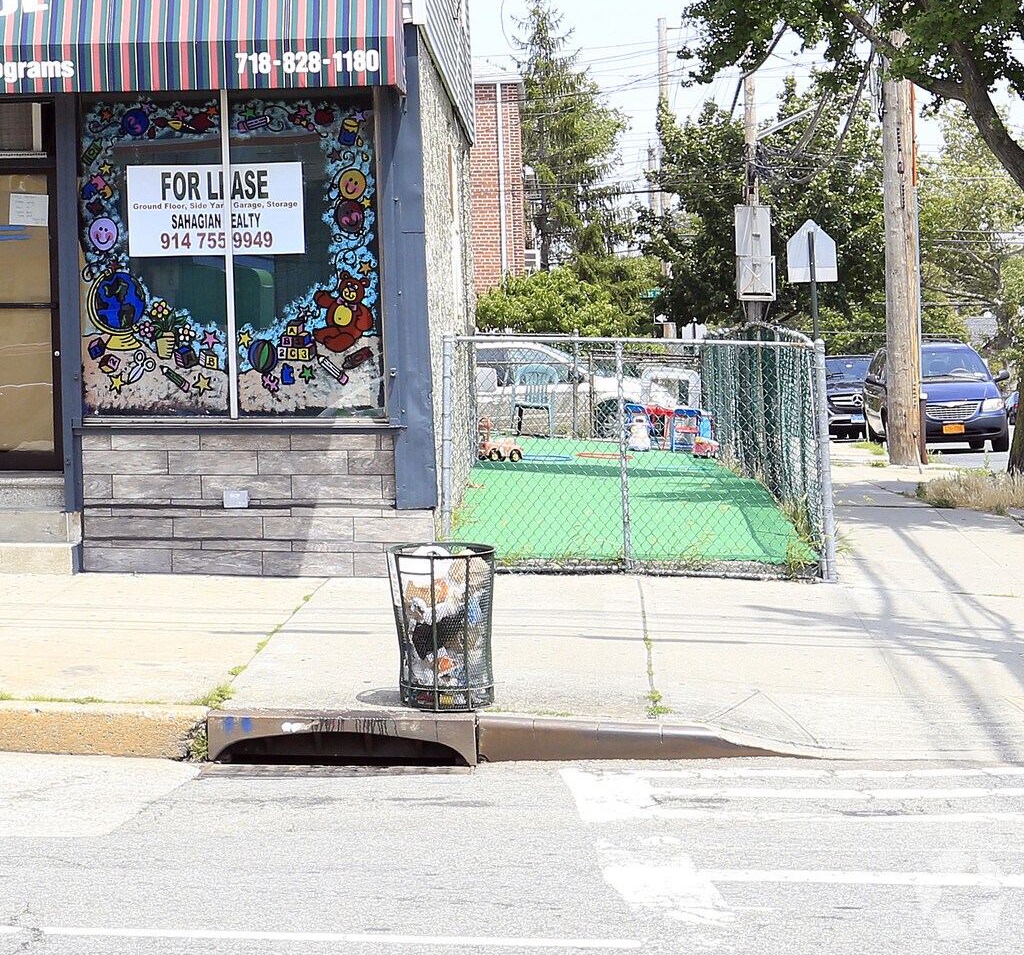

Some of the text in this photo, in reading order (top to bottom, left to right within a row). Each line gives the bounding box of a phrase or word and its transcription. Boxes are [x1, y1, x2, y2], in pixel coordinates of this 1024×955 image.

[235, 49, 380, 75] 718-828-1180
[161, 171, 201, 201] FOR
[164, 202, 188, 211] Floor,
[190, 202, 208, 210] Side
[209, 202, 225, 210] Yar
[266, 200, 298, 209] Storage
[171, 212, 261, 229] SAHAGIAN EALTY
[160, 230, 273, 250] 914 755 9949
